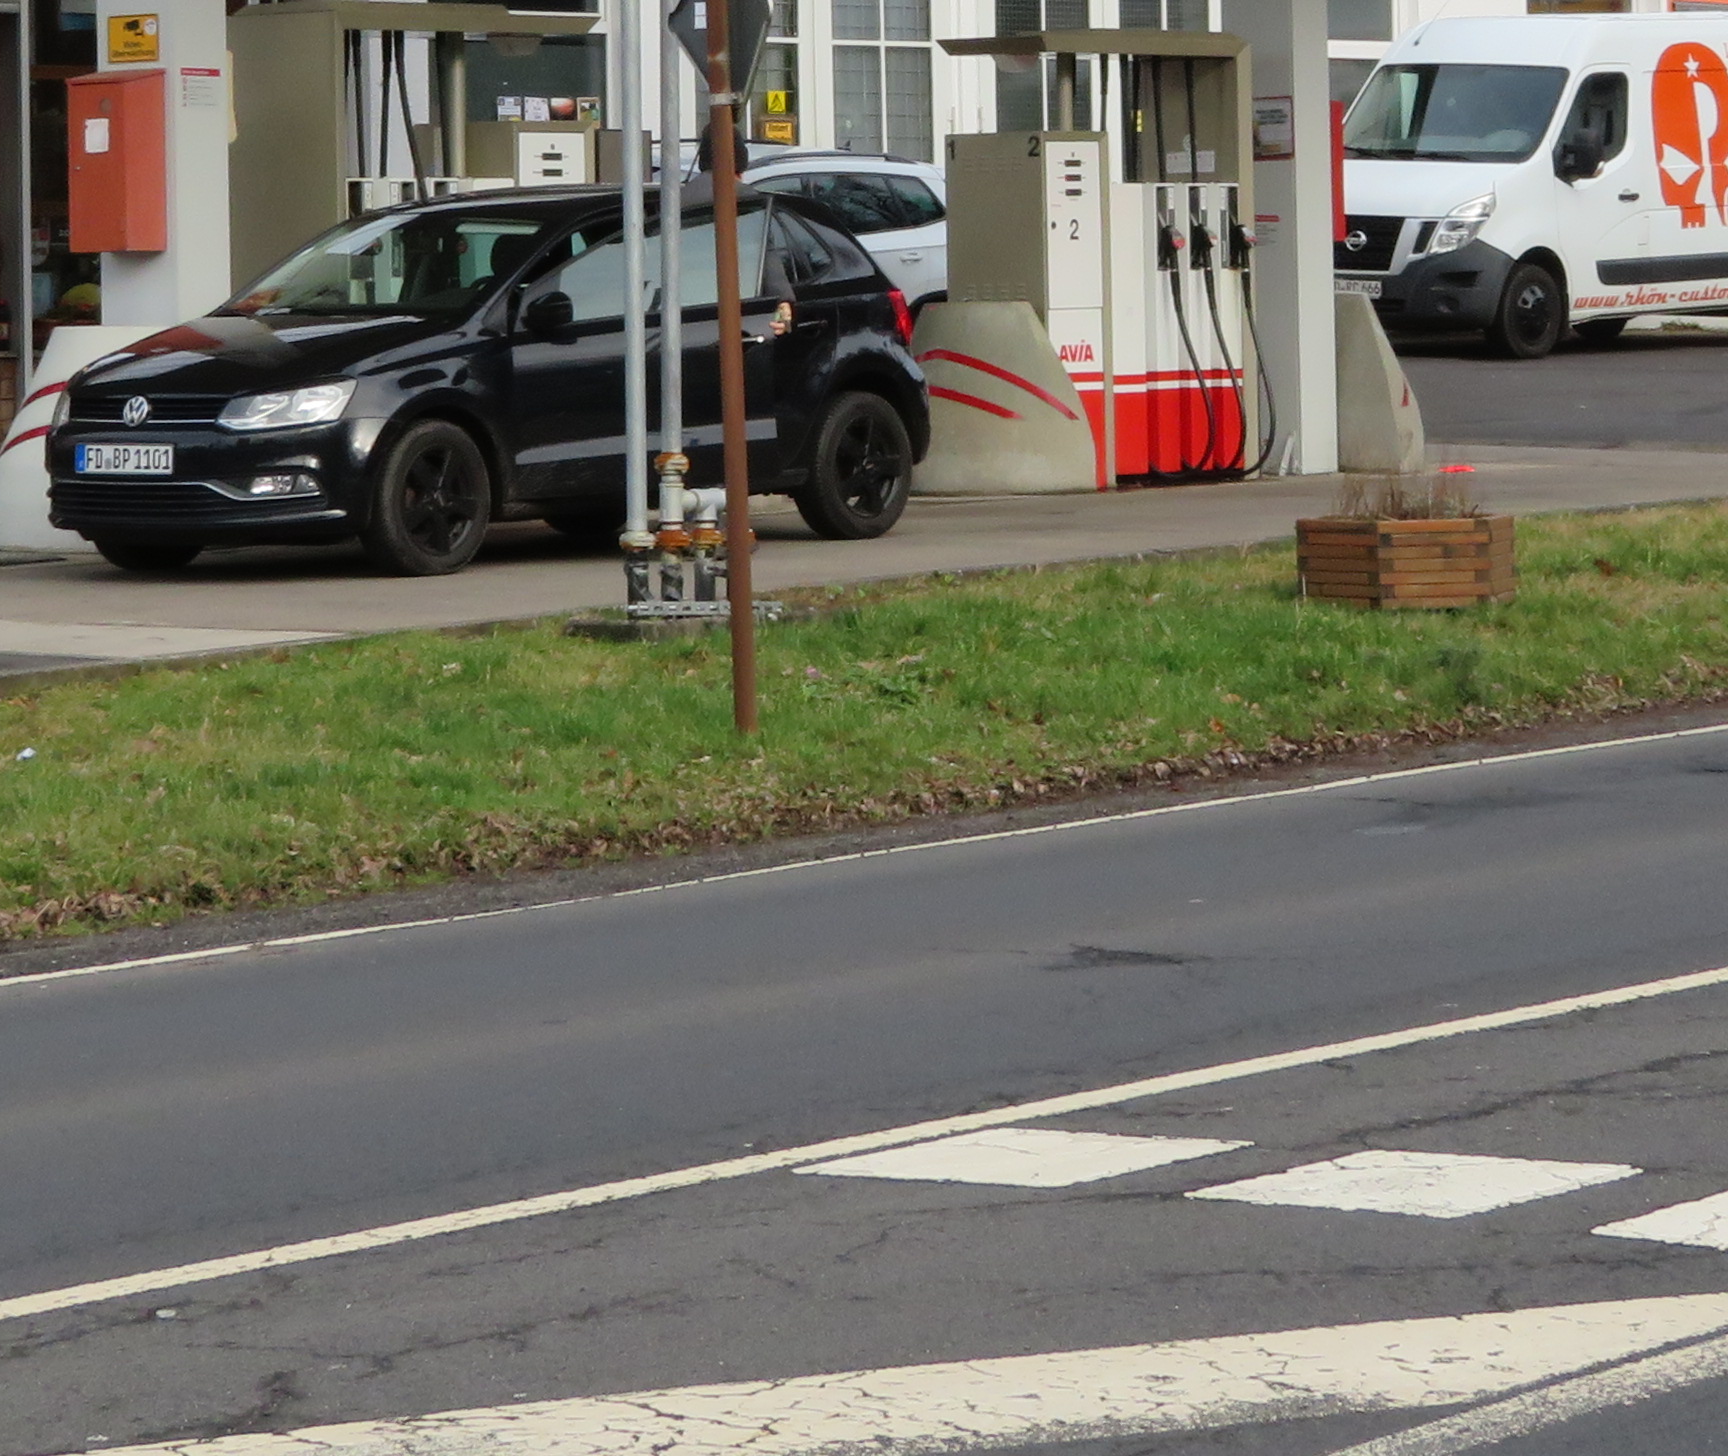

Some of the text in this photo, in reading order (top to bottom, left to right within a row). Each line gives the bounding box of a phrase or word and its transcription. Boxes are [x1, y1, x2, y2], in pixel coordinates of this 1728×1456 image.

[1028, 135, 1040, 158] 2
[1069, 218, 1079, 240] 2
[1058, 339, 1094, 362] AVIA
[86, 447, 171, 470] FD BP 1101
